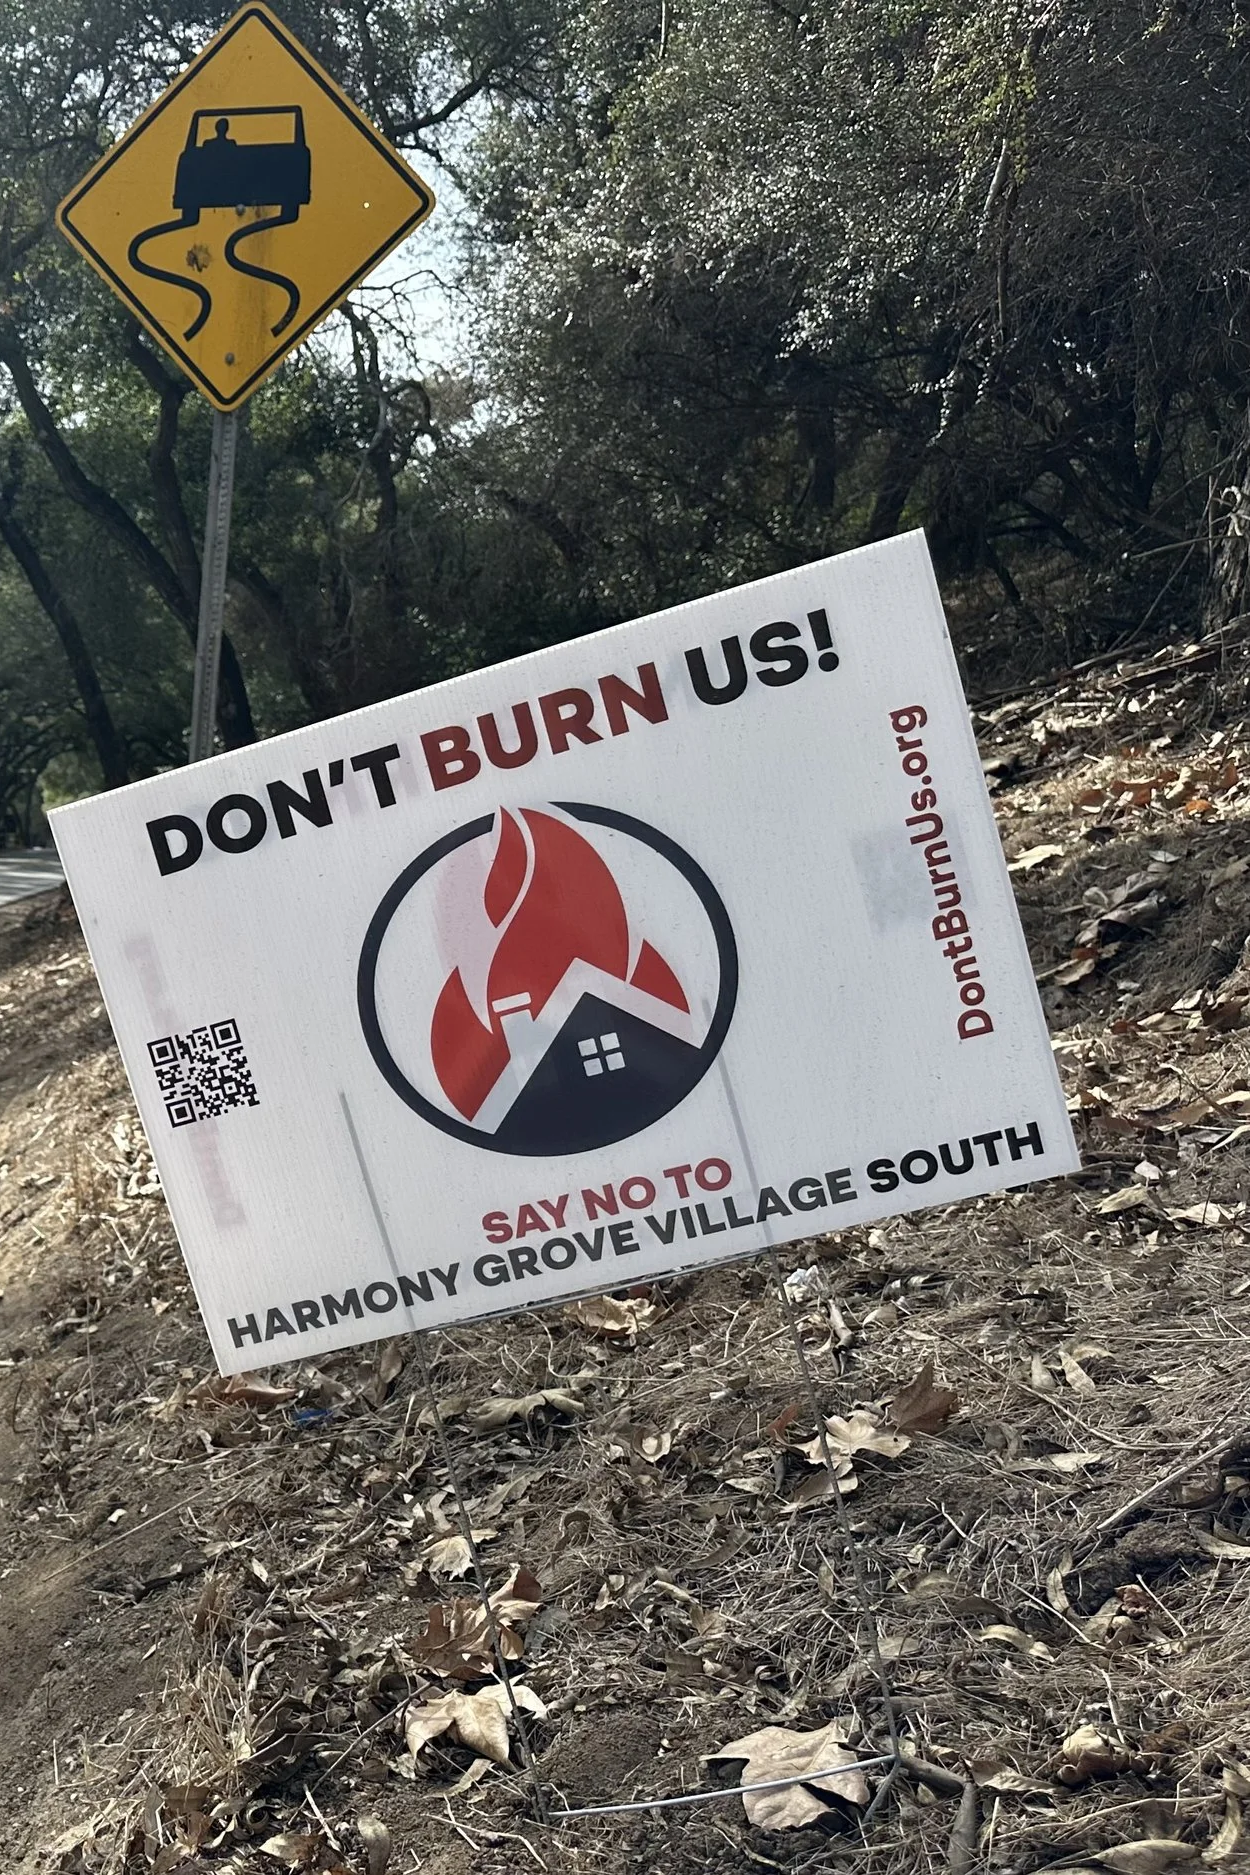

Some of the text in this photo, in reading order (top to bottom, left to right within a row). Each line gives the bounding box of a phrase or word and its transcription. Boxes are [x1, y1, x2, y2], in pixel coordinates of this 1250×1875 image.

[146, 608, 841, 877] DON'T BURN US!
[889, 704, 994, 1040] DontBurnUs.org
[226, 1121, 1045, 1348] HARMONY GROVE VILLAGE SOUTH
[482, 1157, 732, 1244] SAY NO TO
